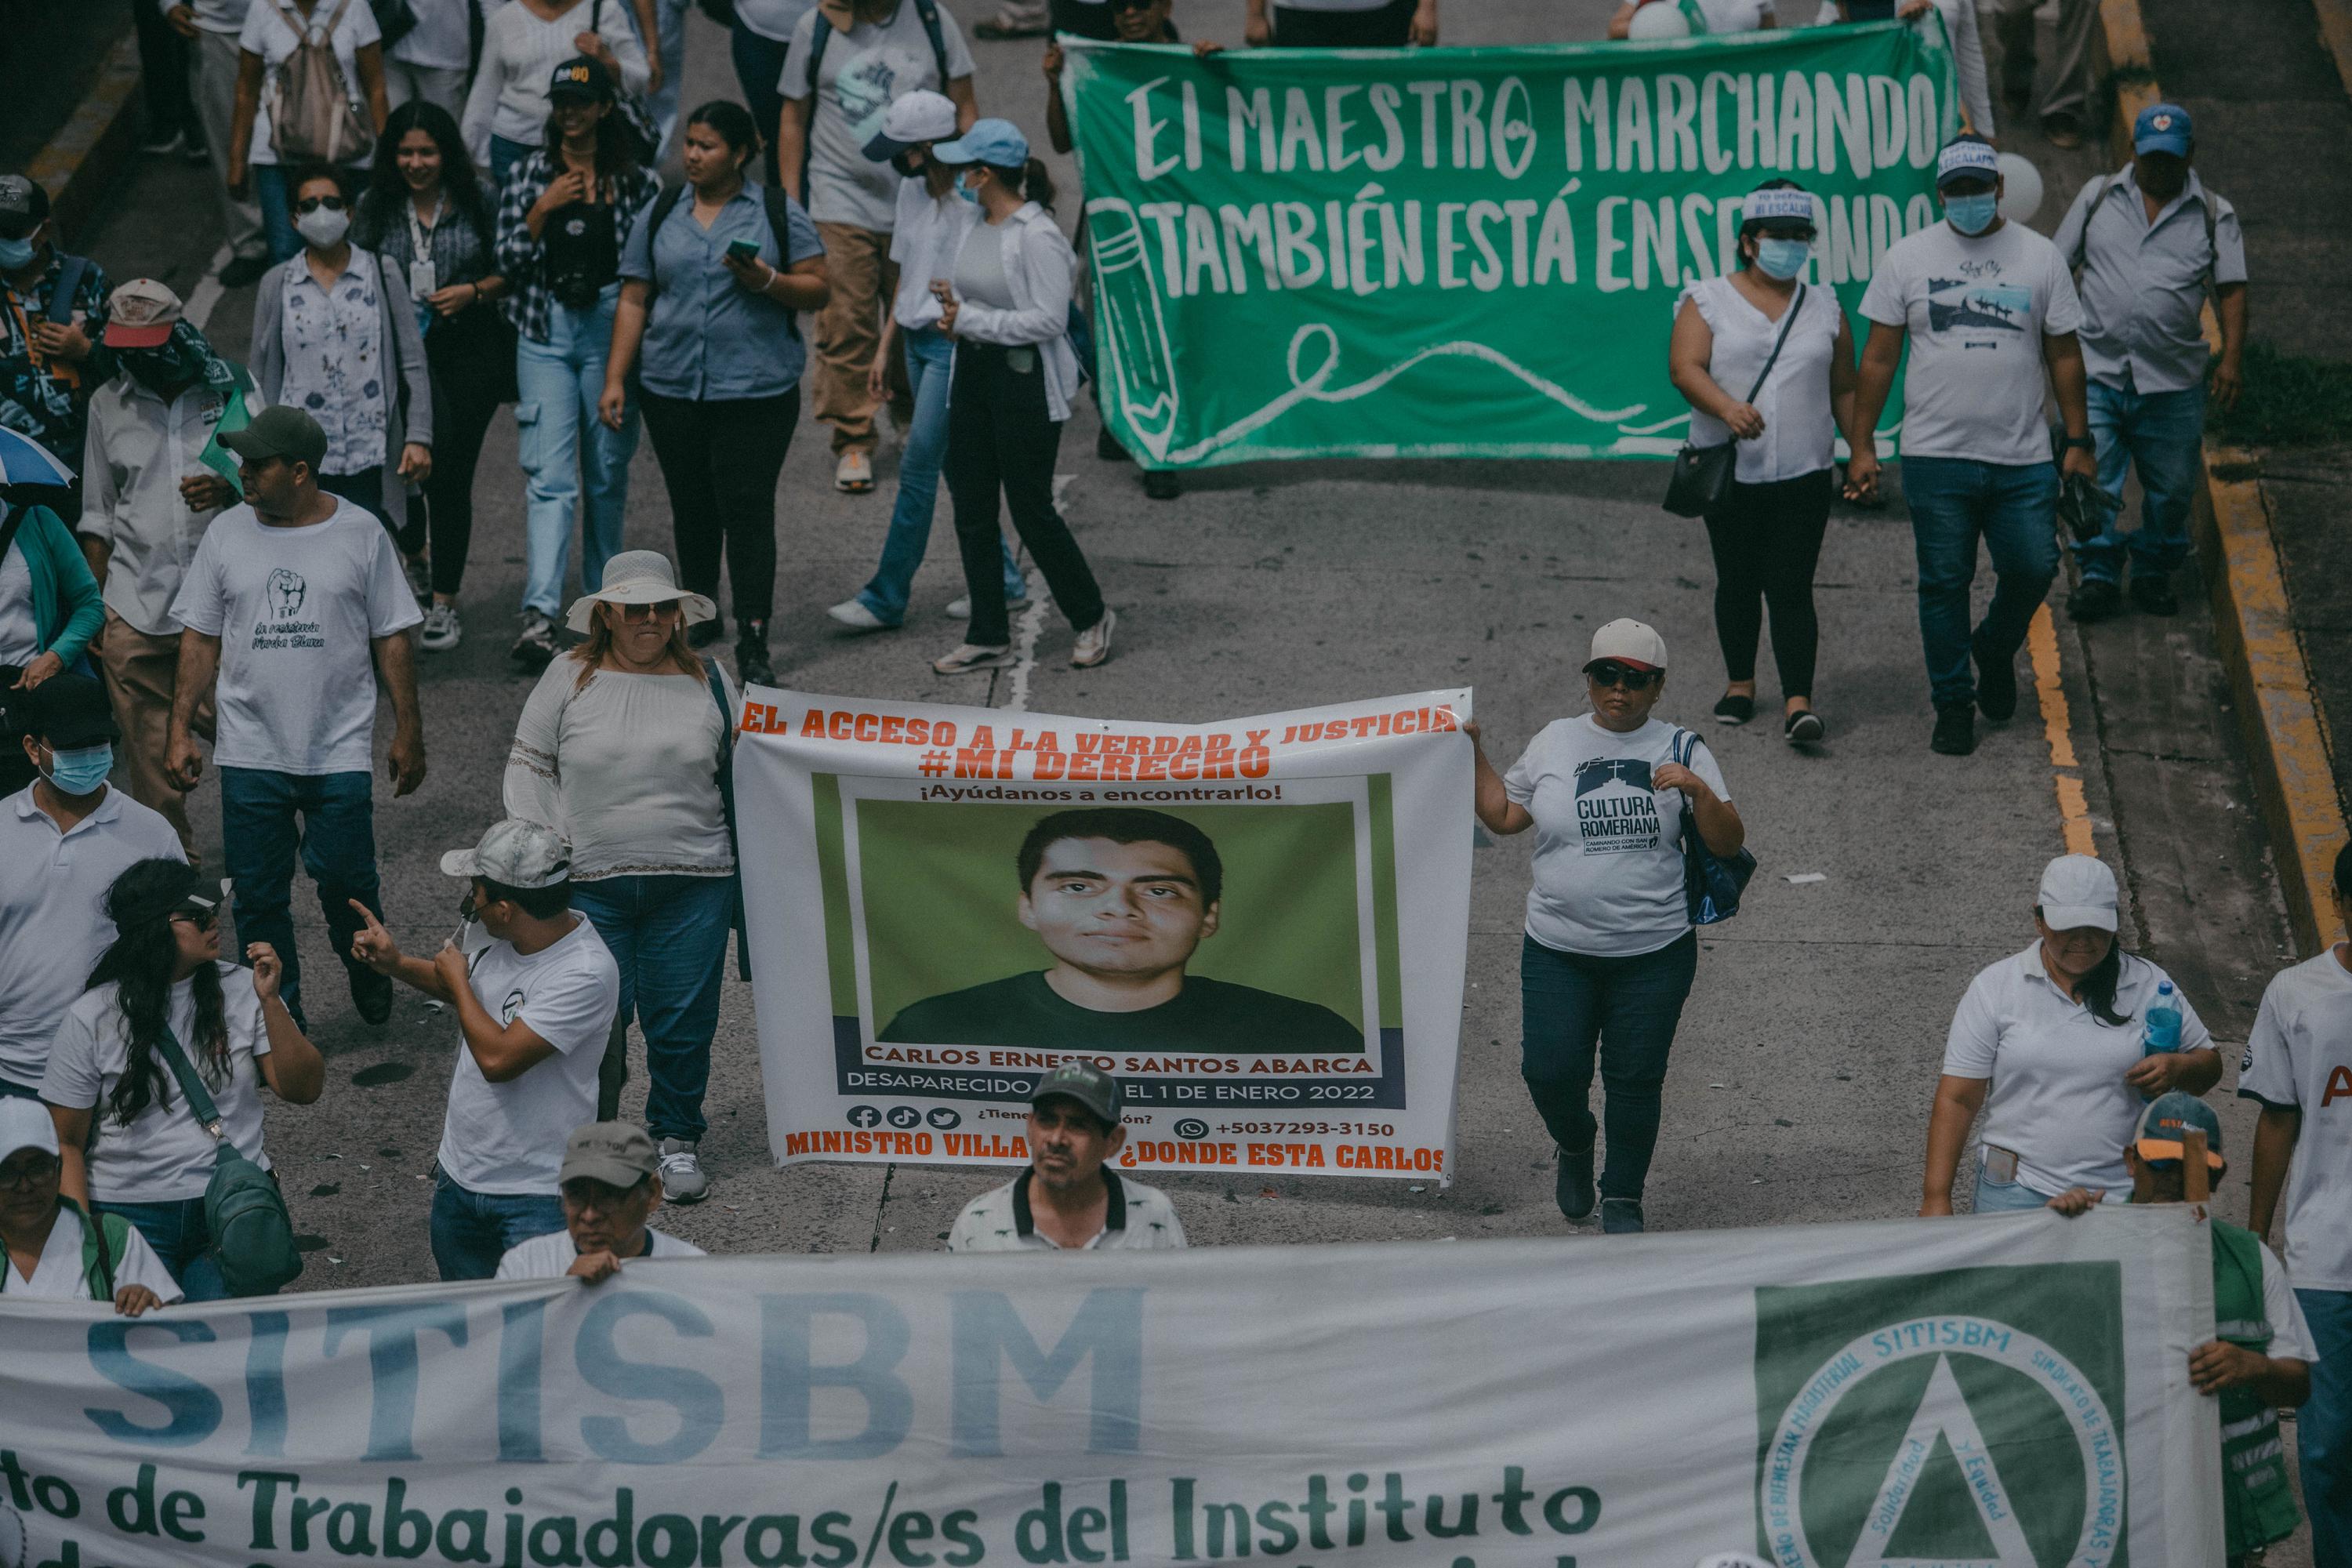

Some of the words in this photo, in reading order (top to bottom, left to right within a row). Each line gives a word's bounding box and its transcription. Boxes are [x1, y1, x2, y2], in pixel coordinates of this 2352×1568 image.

[1225, 76, 1537, 180] MAESTRO
[1563, 70, 1938, 180] MARCHANDO
[1138, 181, 1425, 299] TAMBIÉN
[1436, 177, 1581, 292] ESTÁ
[740, 701, 787, 735] EL
[800, 709, 956, 748] ACCESO
[969, 724, 995, 749] A
[1009, 728, 1058, 752] LA
[1075, 733, 1232, 756] VERDAD
[1245, 728, 1272, 748] Y
[1279, 704, 1457, 745] JUSTICIA
[917, 747, 1016, 780] #MI
[1033, 746, 1271, 782] DERECHO
[920, 784, 1072, 801] ¡Ayúdanos
[1080, 788, 1095, 800] a
[1103, 785, 1282, 801] encontrarlo!
[1577, 796, 1657, 820] CULTURA
[1580, 816, 1661, 838] ROMERIANA
[865, 1046, 980, 1065] CARLOS
[989, 1051, 1115, 1071] ERNESTO
[1125, 1056, 1242, 1074] SANTOS
[1249, 1058, 1374, 1074] ABARCA
[847, 1073, 1032, 1094] DESAPARECIDO
[1125, 1084, 1155, 1098] EL
[1160, 1085, 1167, 1098] 1
[1176, 1086, 1207, 1099] DE
[1215, 1086, 1300, 1100] ENERO
[1309, 1086, 1374, 1099] 2022
[1216, 1122, 1394, 1137] +5037293-3150
[786, 1131, 932, 1156] MINISTRO
[943, 1133, 1029, 1158] VILLA
[1120, 1142, 1236, 1167] ¿DONDE
[1247, 1143, 1326, 1167] ESTA
[1336, 1145, 1443, 1173] CARLOS
[1871, 1319, 2012, 1358] SITISBM
[84, 1287, 1149, 1465] SITISBM
[2031, 1349, 2090, 1408] SINDICATO
[2082, 1408, 2101, 1428] DE
[1871, 1438, 1926, 1534] Solidaridad
[1965, 1456, 2007, 1521] Equidad
[2091, 1429, 2118, 1548] TRABAJADORAS
[106, 1463, 205, 1543] de
[238, 1470, 985, 1568] Trabajadoras/es
[1014, 1478, 1131, 1565] del
[1168, 1465, 1602, 1560] Instituto
